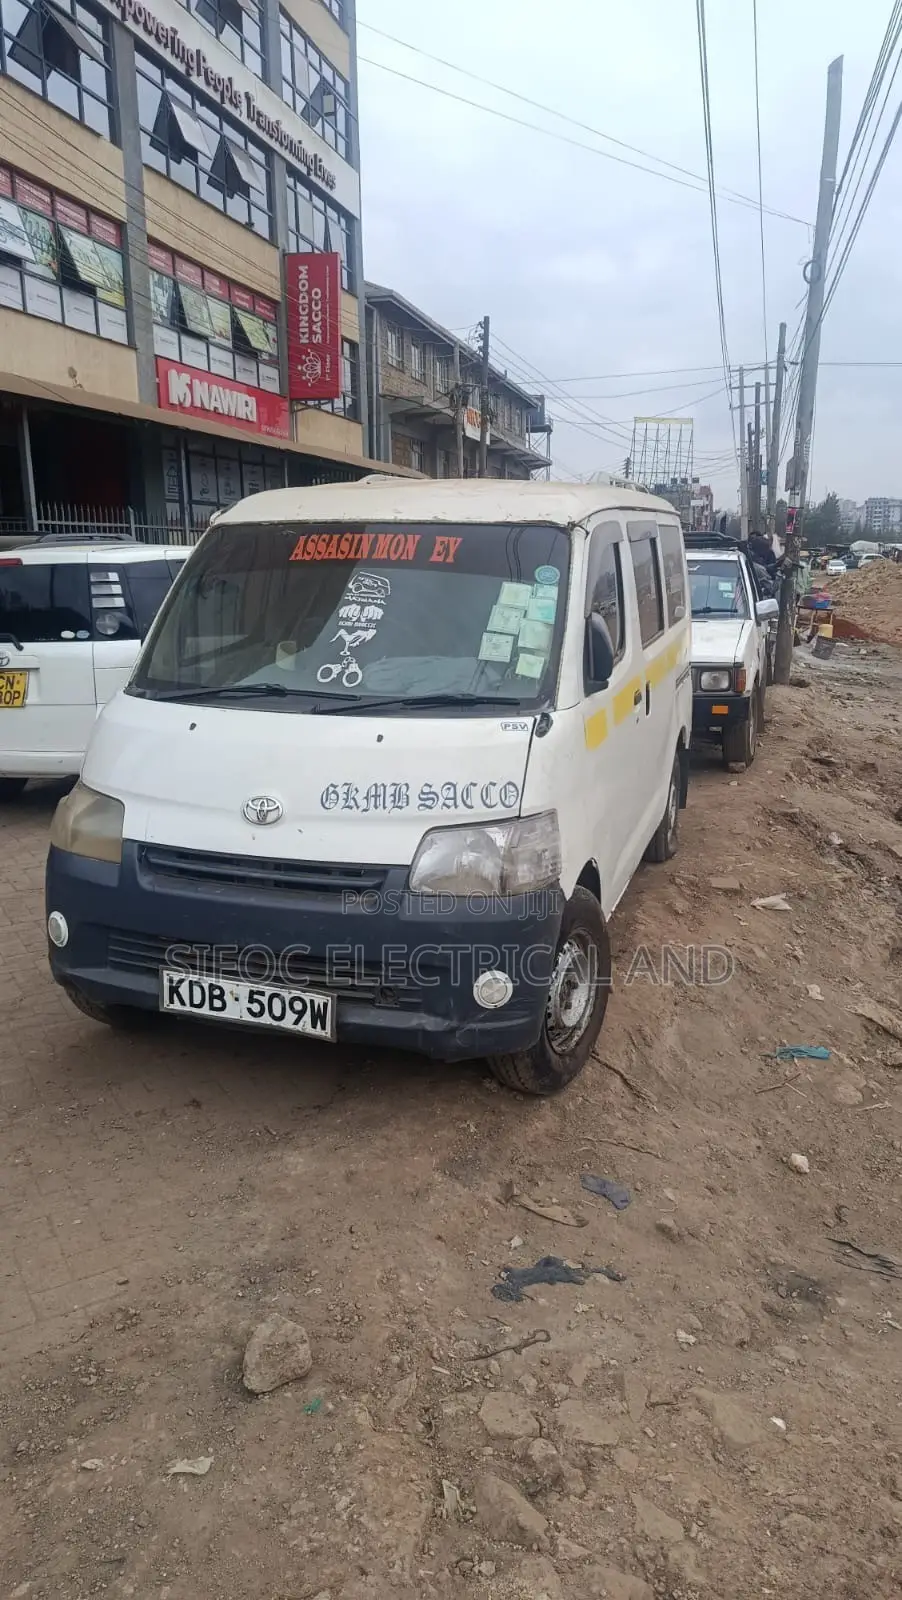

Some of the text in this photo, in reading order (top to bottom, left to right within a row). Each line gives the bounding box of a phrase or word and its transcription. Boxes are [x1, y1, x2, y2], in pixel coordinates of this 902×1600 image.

[244, 91, 313, 177] Transforming
[298, 264, 310, 344] KINGDOM
[311, 287, 322, 344] SACCO
[289, 533, 463, 563] ASSASIN MON EY
[417, 781, 520, 811] SACCO
[168, 976, 330, 1032] KDB 509W
